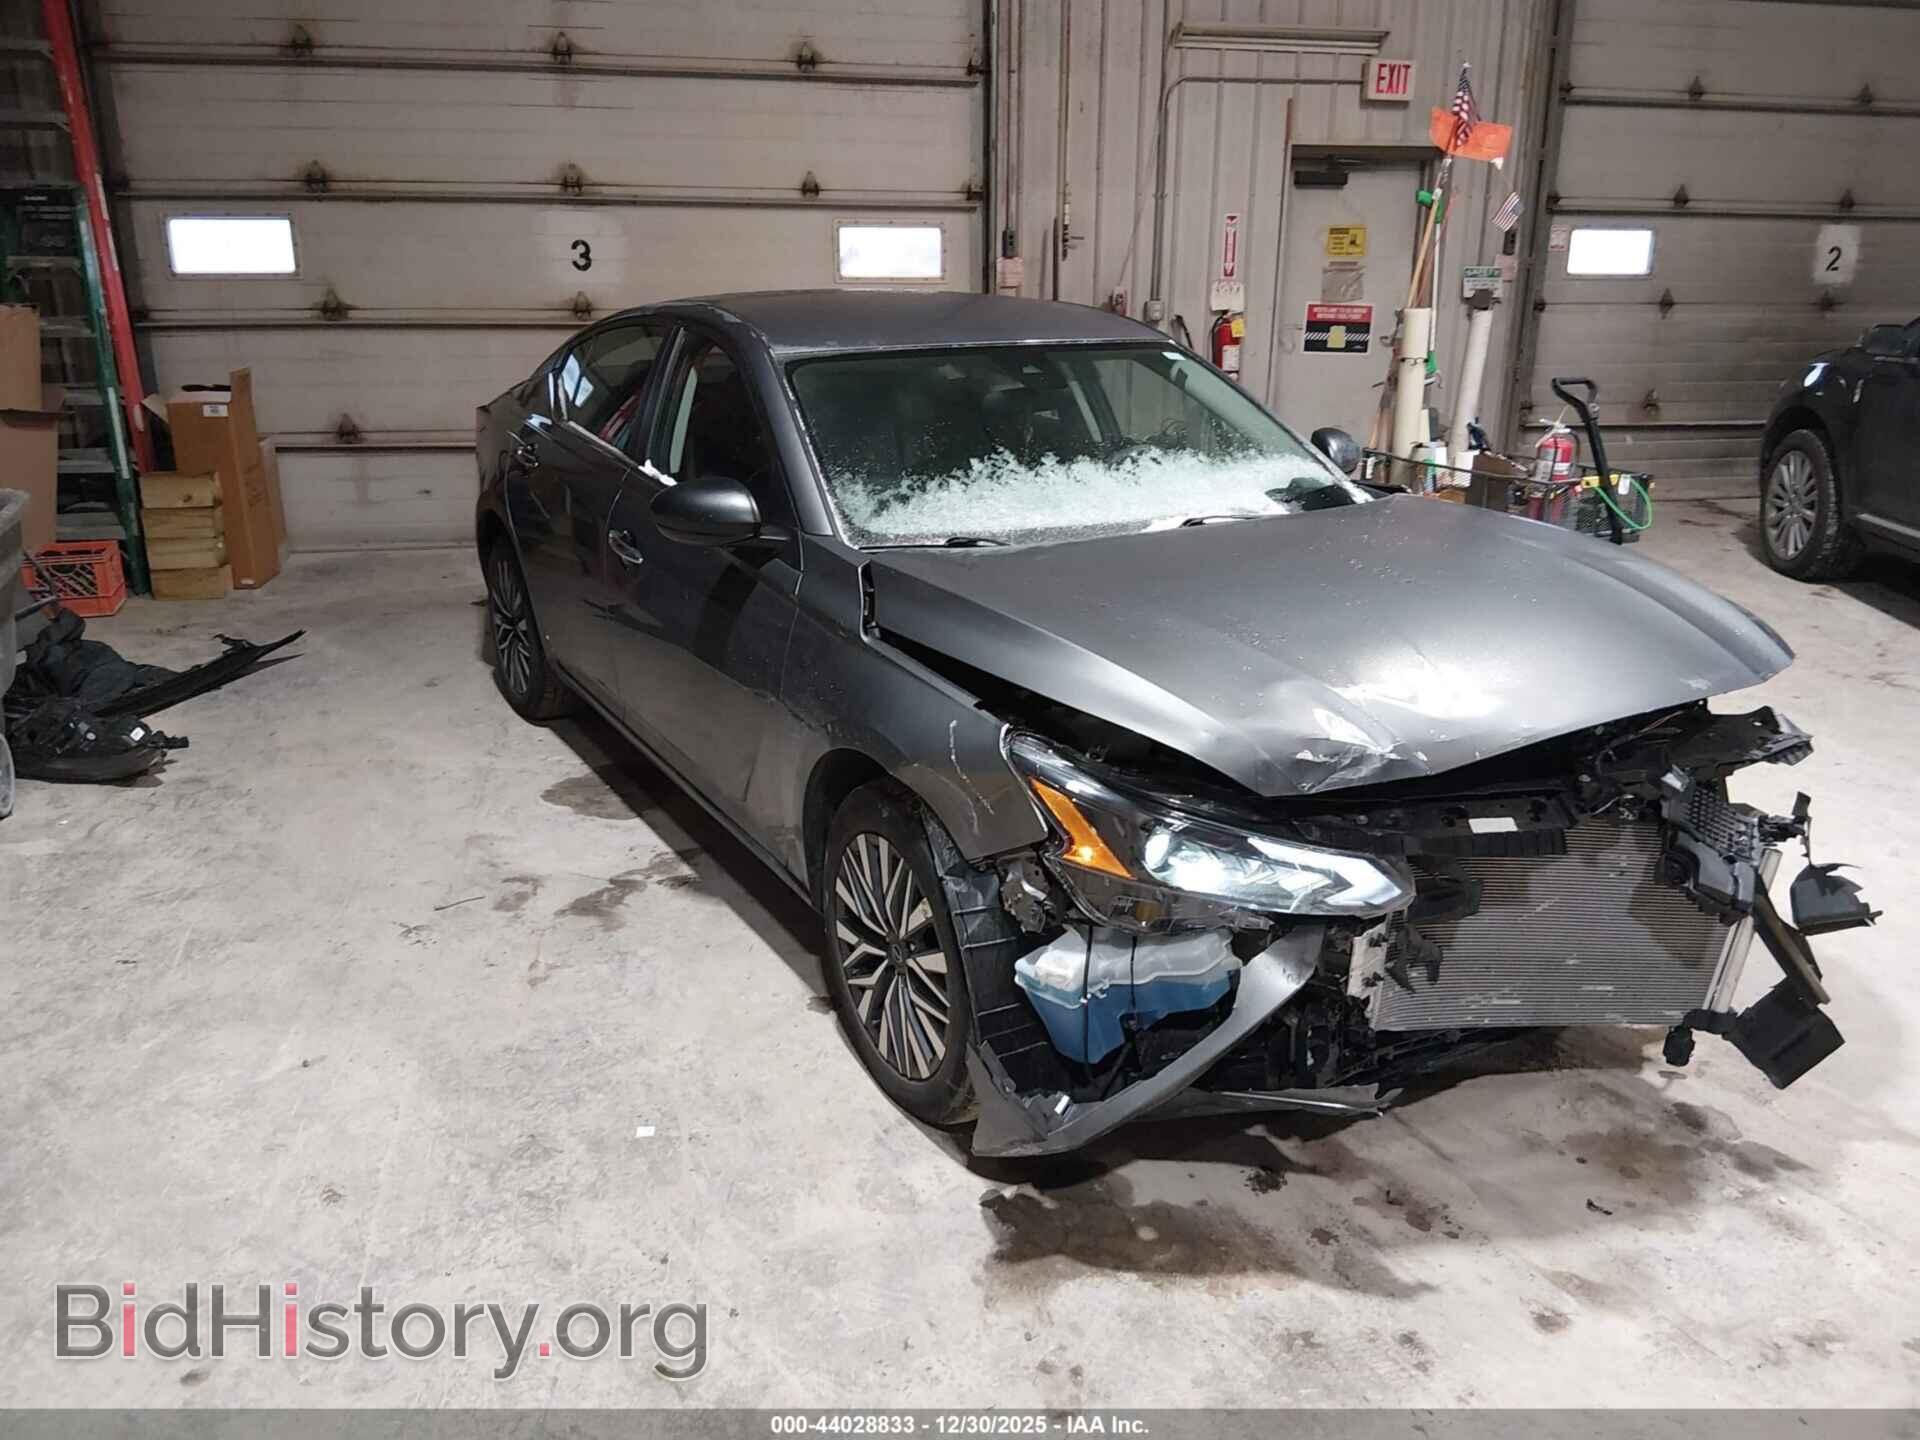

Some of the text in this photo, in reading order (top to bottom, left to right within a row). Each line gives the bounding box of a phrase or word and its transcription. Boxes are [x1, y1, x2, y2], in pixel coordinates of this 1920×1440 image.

[1376, 63, 1411, 95] EXIT
[571, 239, 592, 271] 3
[1825, 246, 1842, 272] 2
